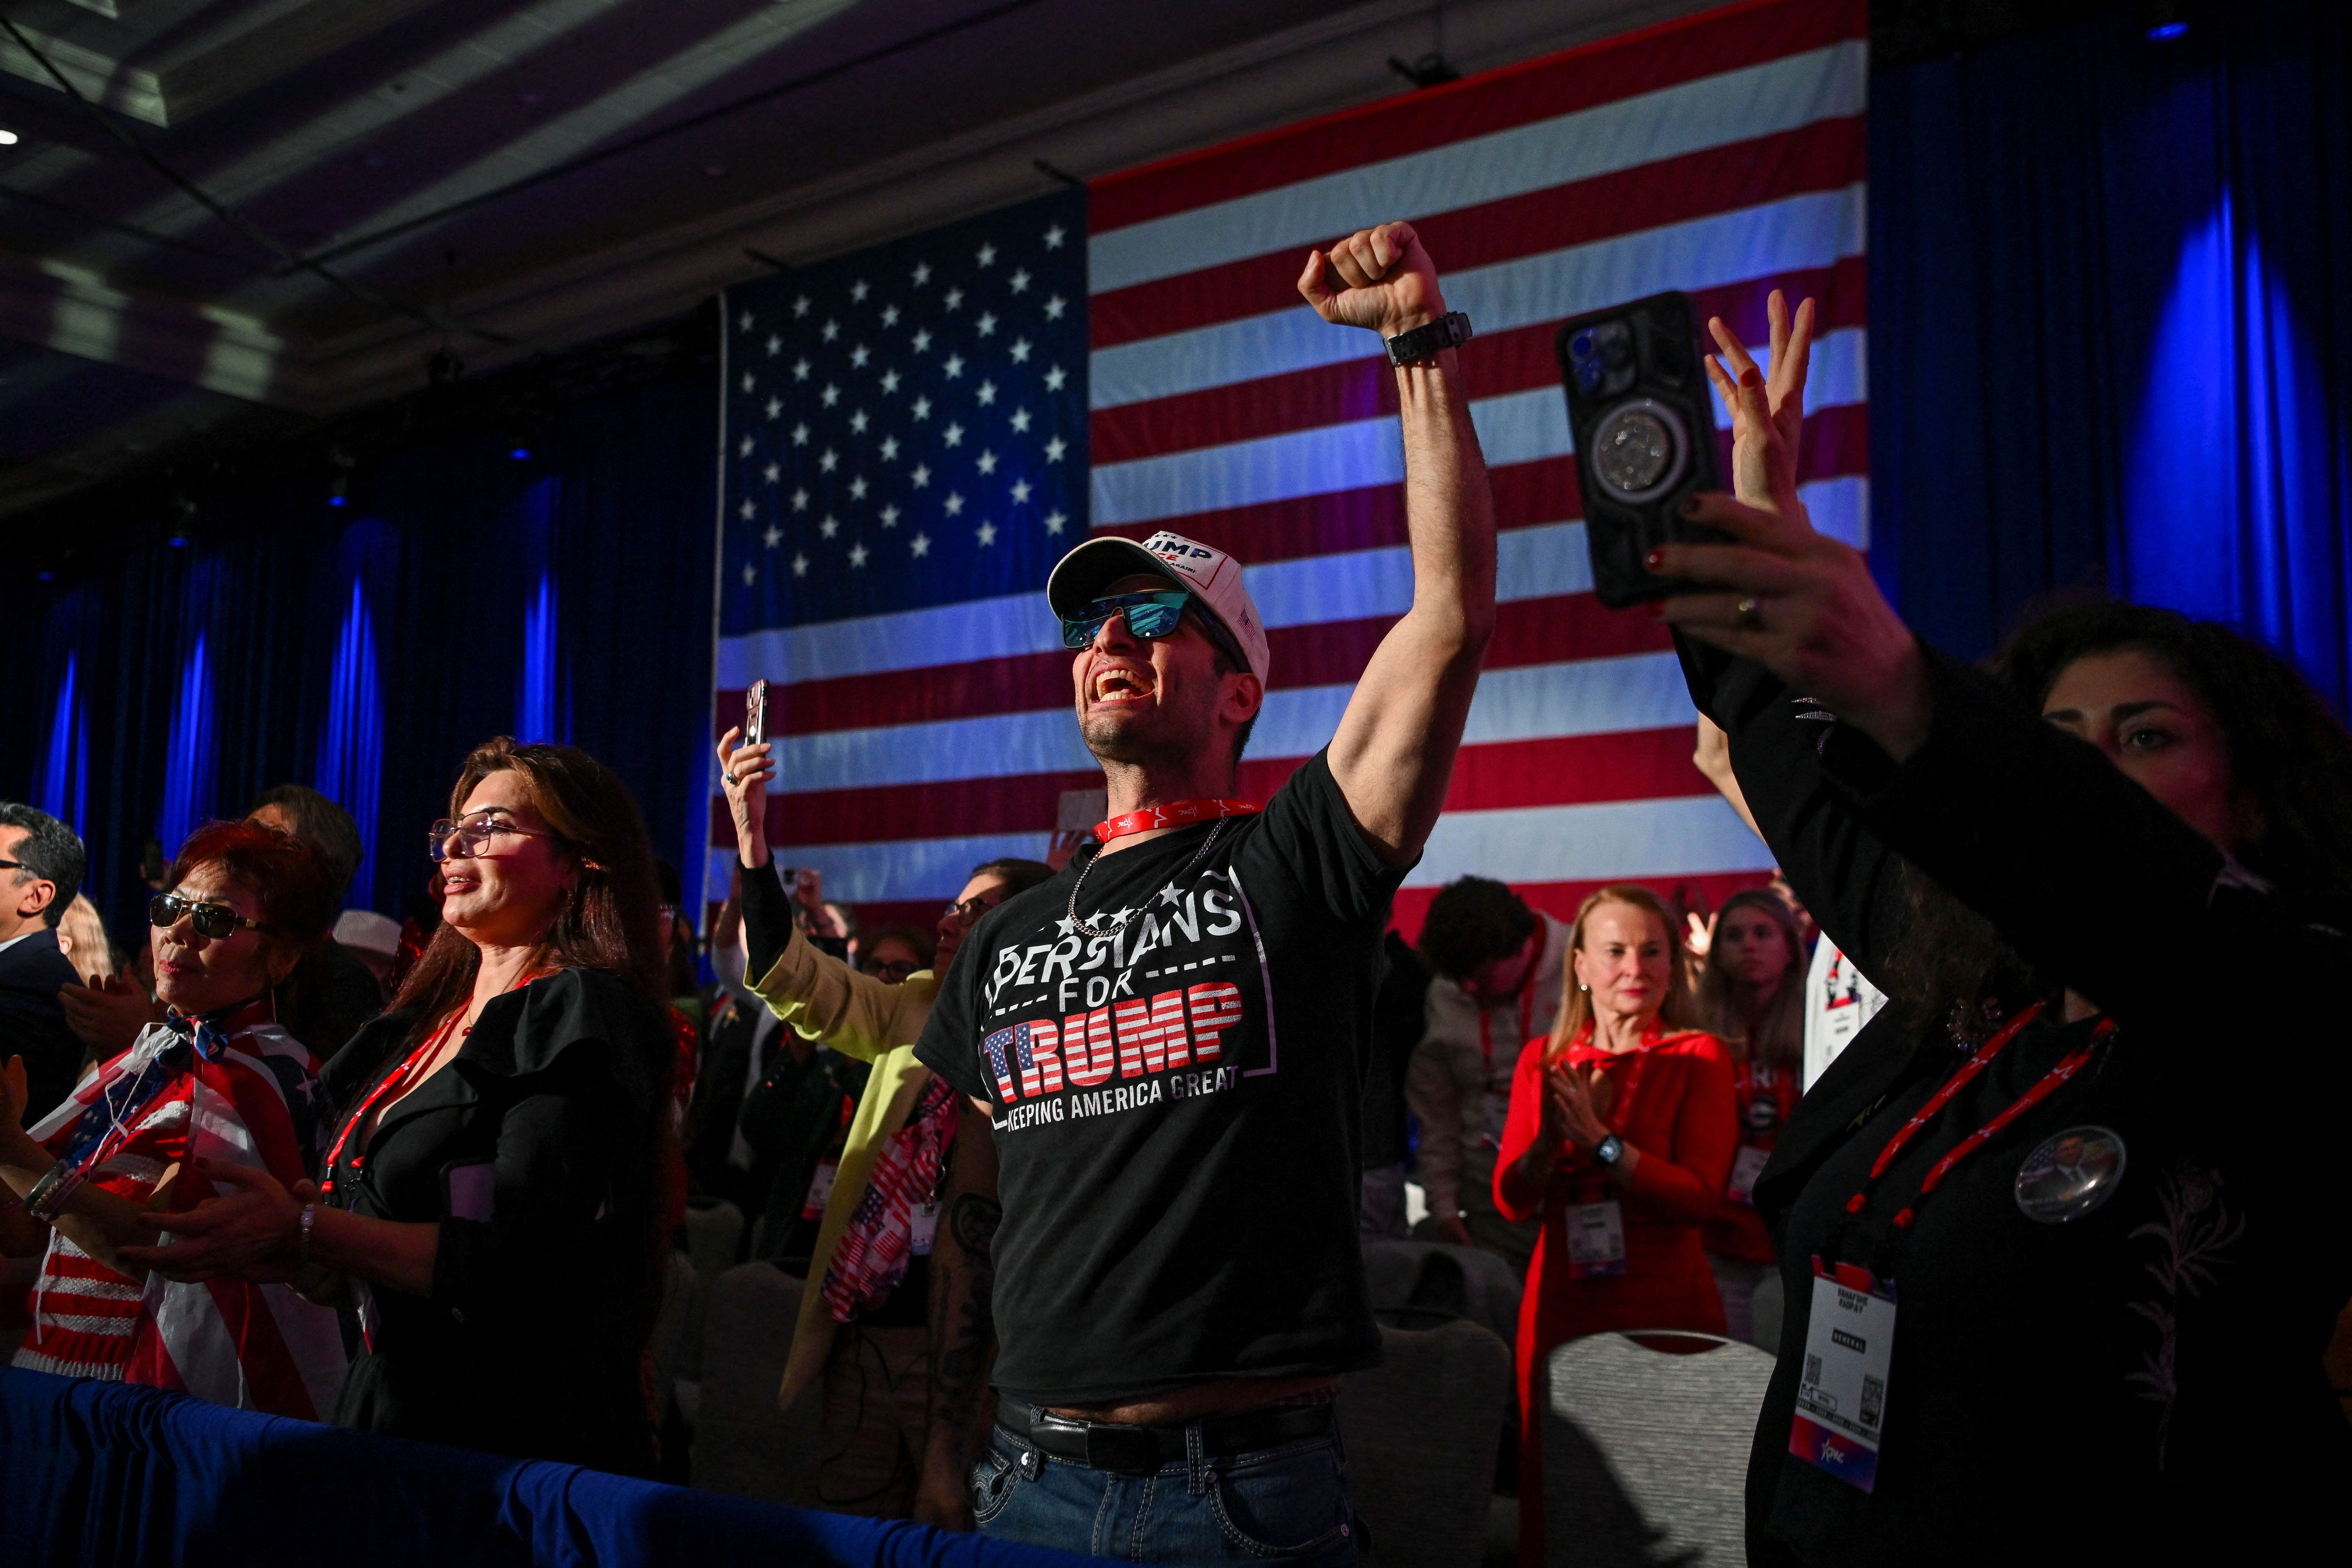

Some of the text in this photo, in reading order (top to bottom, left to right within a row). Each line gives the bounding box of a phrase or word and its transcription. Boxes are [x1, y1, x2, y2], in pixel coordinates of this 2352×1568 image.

[1143, 540, 1211, 558] UMP
[1117, 818, 1129, 828] CPAC
[993, 889, 1241, 1003] PERSIANS
[1059, 968, 1135, 1012] FOR
[984, 982, 1243, 1104] TRUMP
[1008, 1066, 1238, 1132] KEEPING AMERICA GREAT
